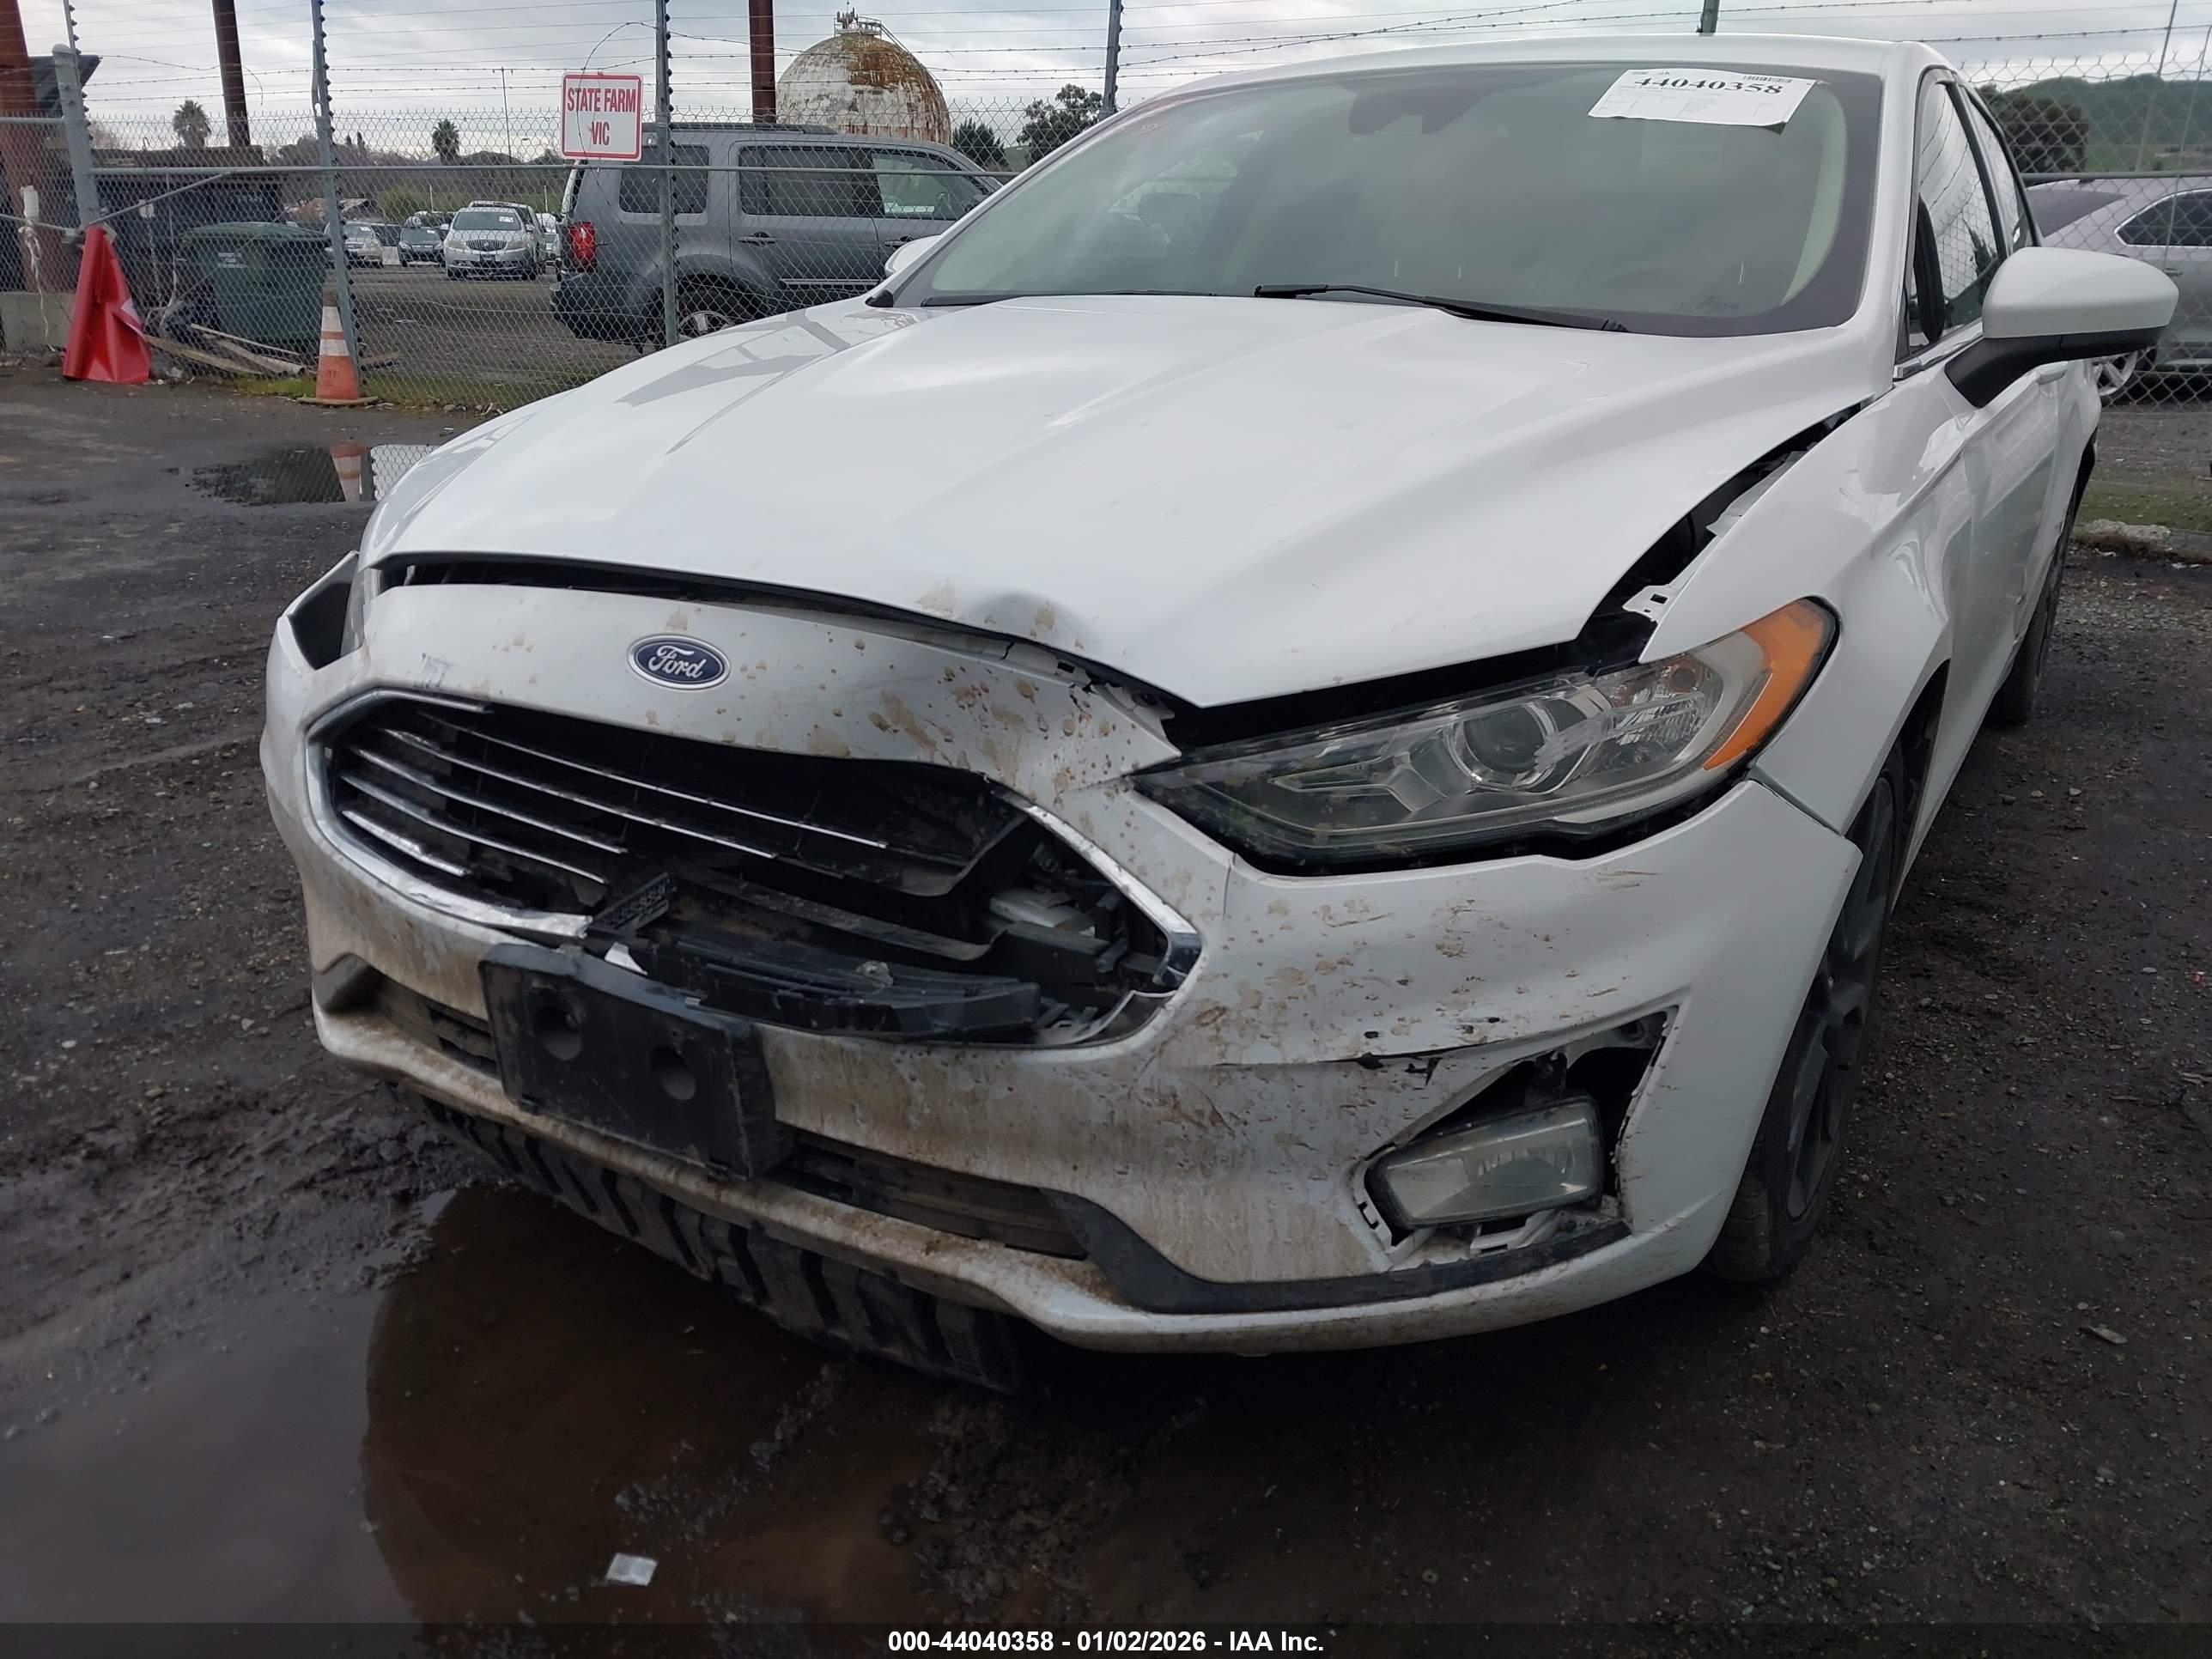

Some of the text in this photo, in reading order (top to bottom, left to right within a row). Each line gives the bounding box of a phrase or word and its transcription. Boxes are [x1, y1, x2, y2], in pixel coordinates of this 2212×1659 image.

[1634, 77, 1783, 94] 44040358
[567, 88, 636, 112] STATE FARM
[591, 121, 611, 145] VIC
[648, 645, 707, 678] Ford
